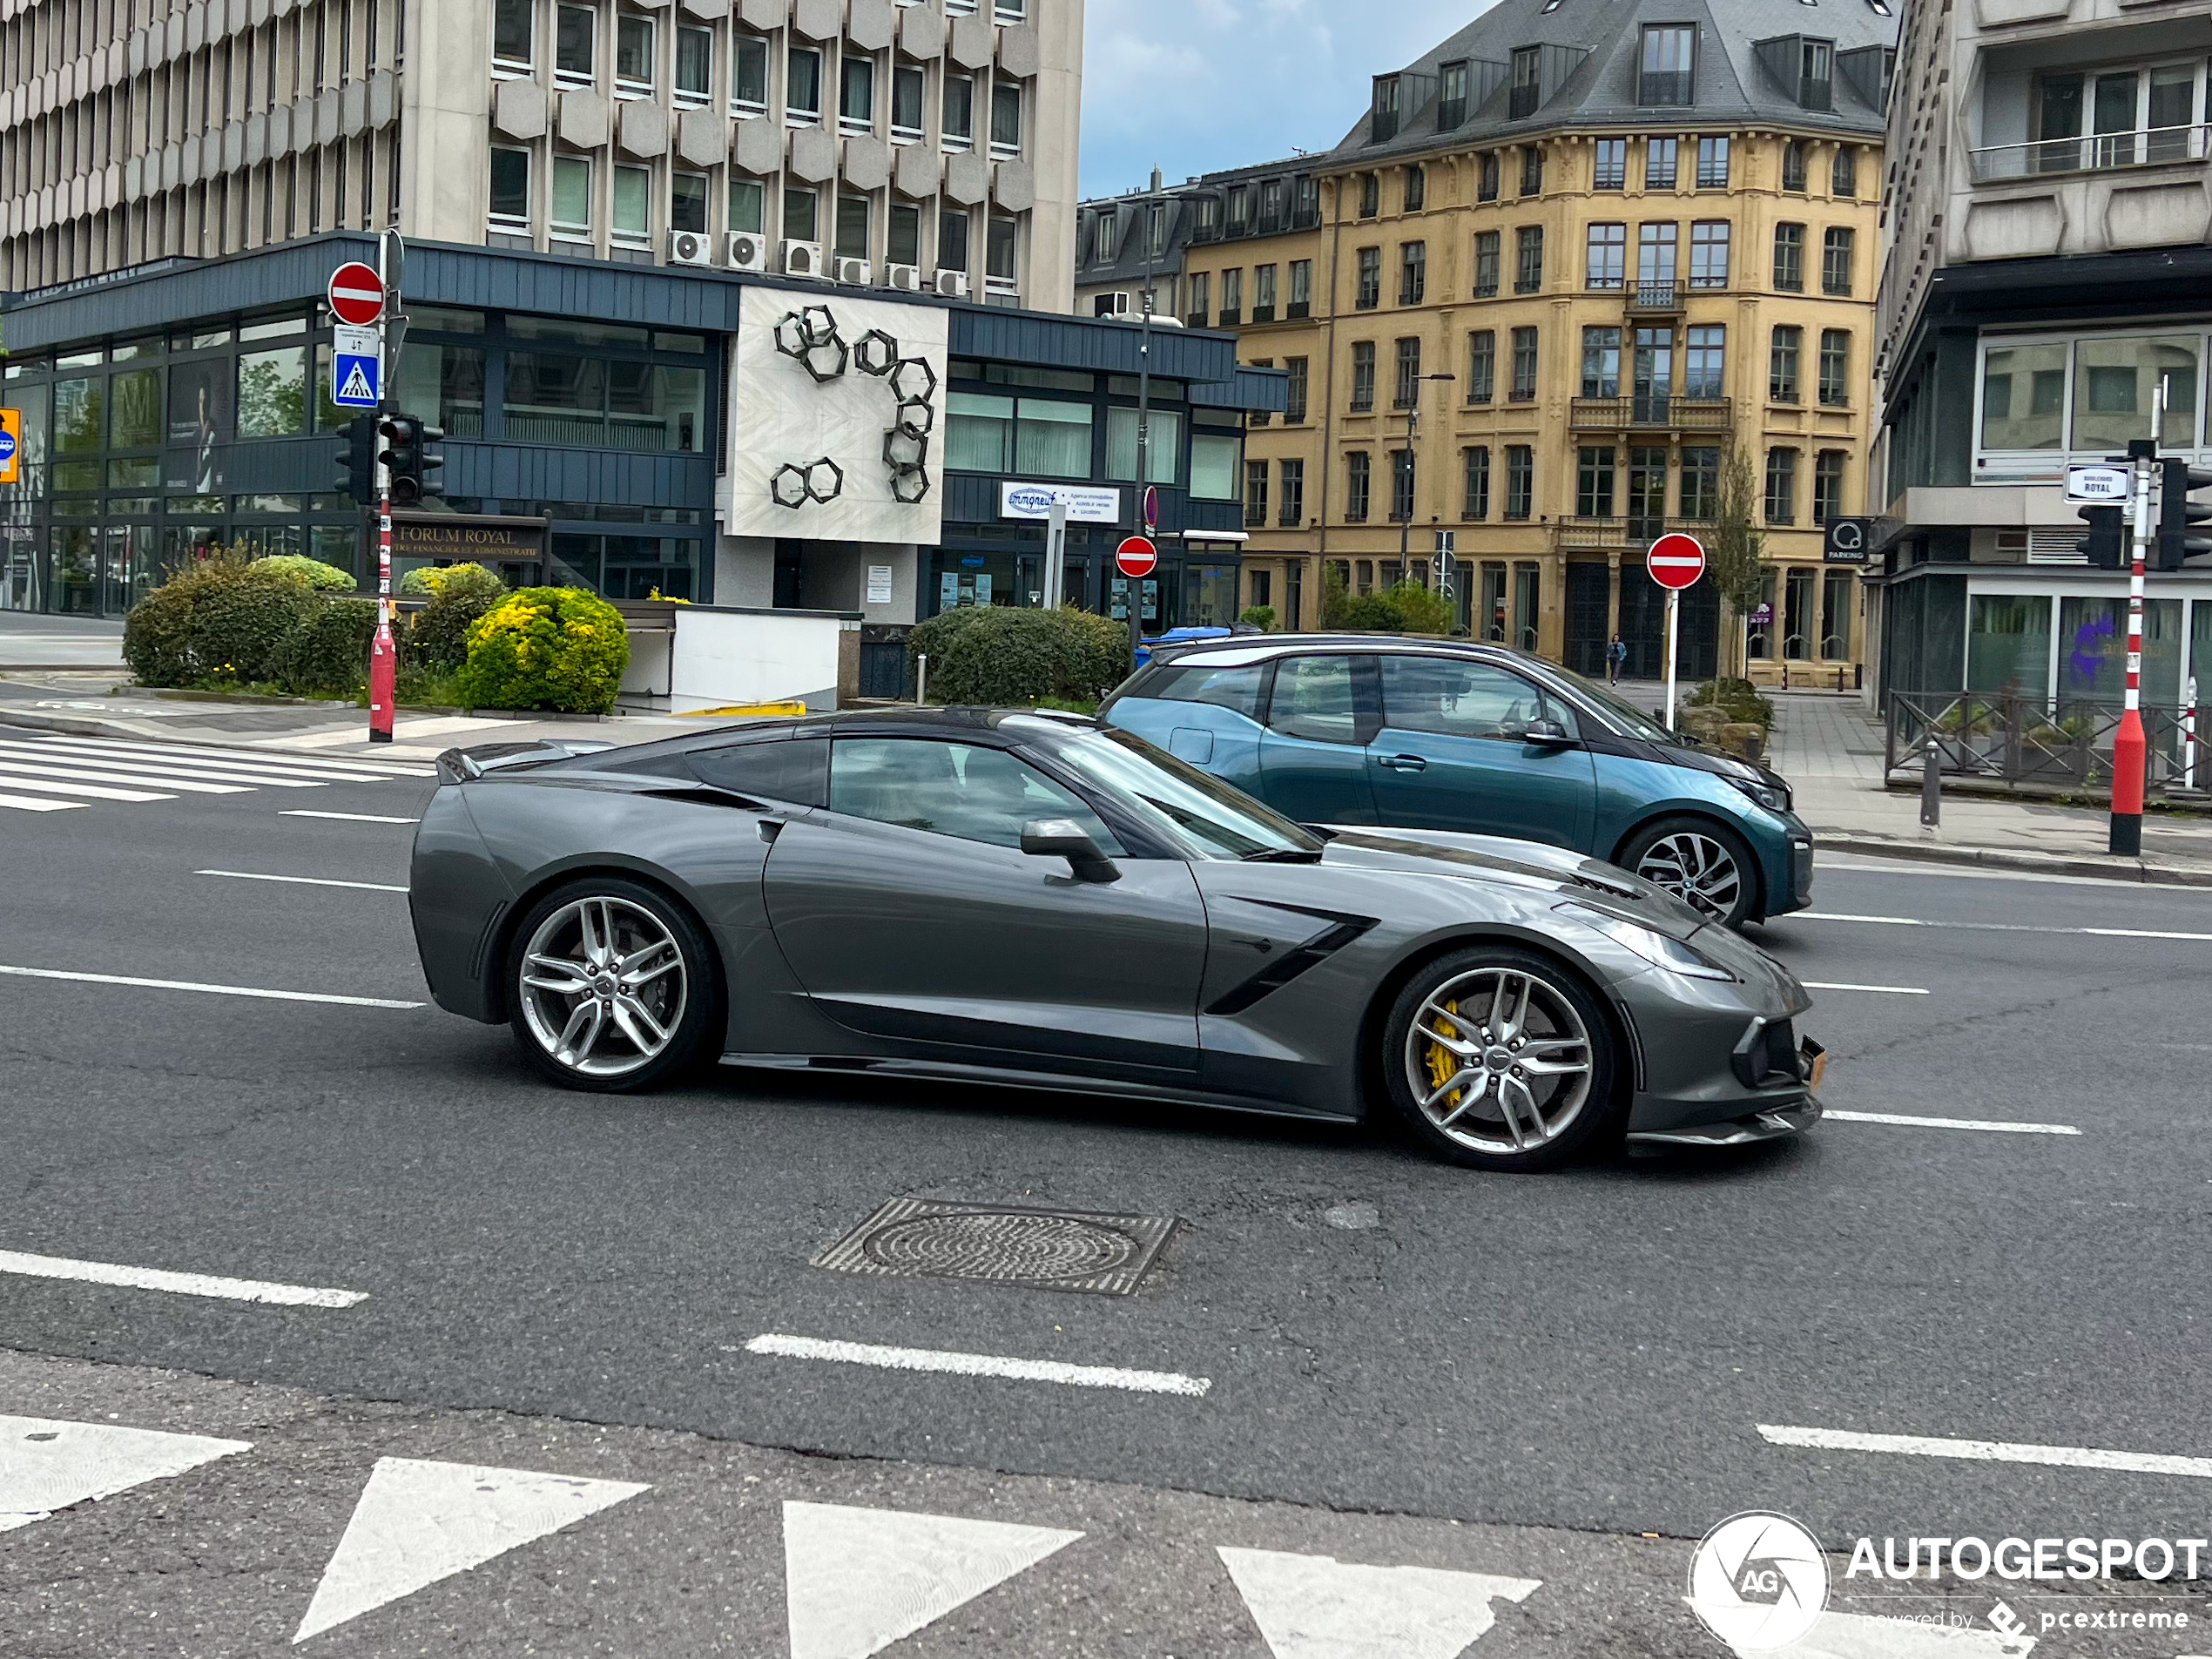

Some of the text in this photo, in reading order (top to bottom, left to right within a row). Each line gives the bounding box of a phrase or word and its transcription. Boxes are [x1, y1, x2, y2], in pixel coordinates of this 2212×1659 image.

[2084, 483, 2111, 493] ROYAL
[401, 526, 517, 545] FORUM ROYAL
[413, 543, 459, 554] FINANCIER
[461, 546, 472, 555] ET
[475, 547, 538, 556] ADMINISTRATIF
